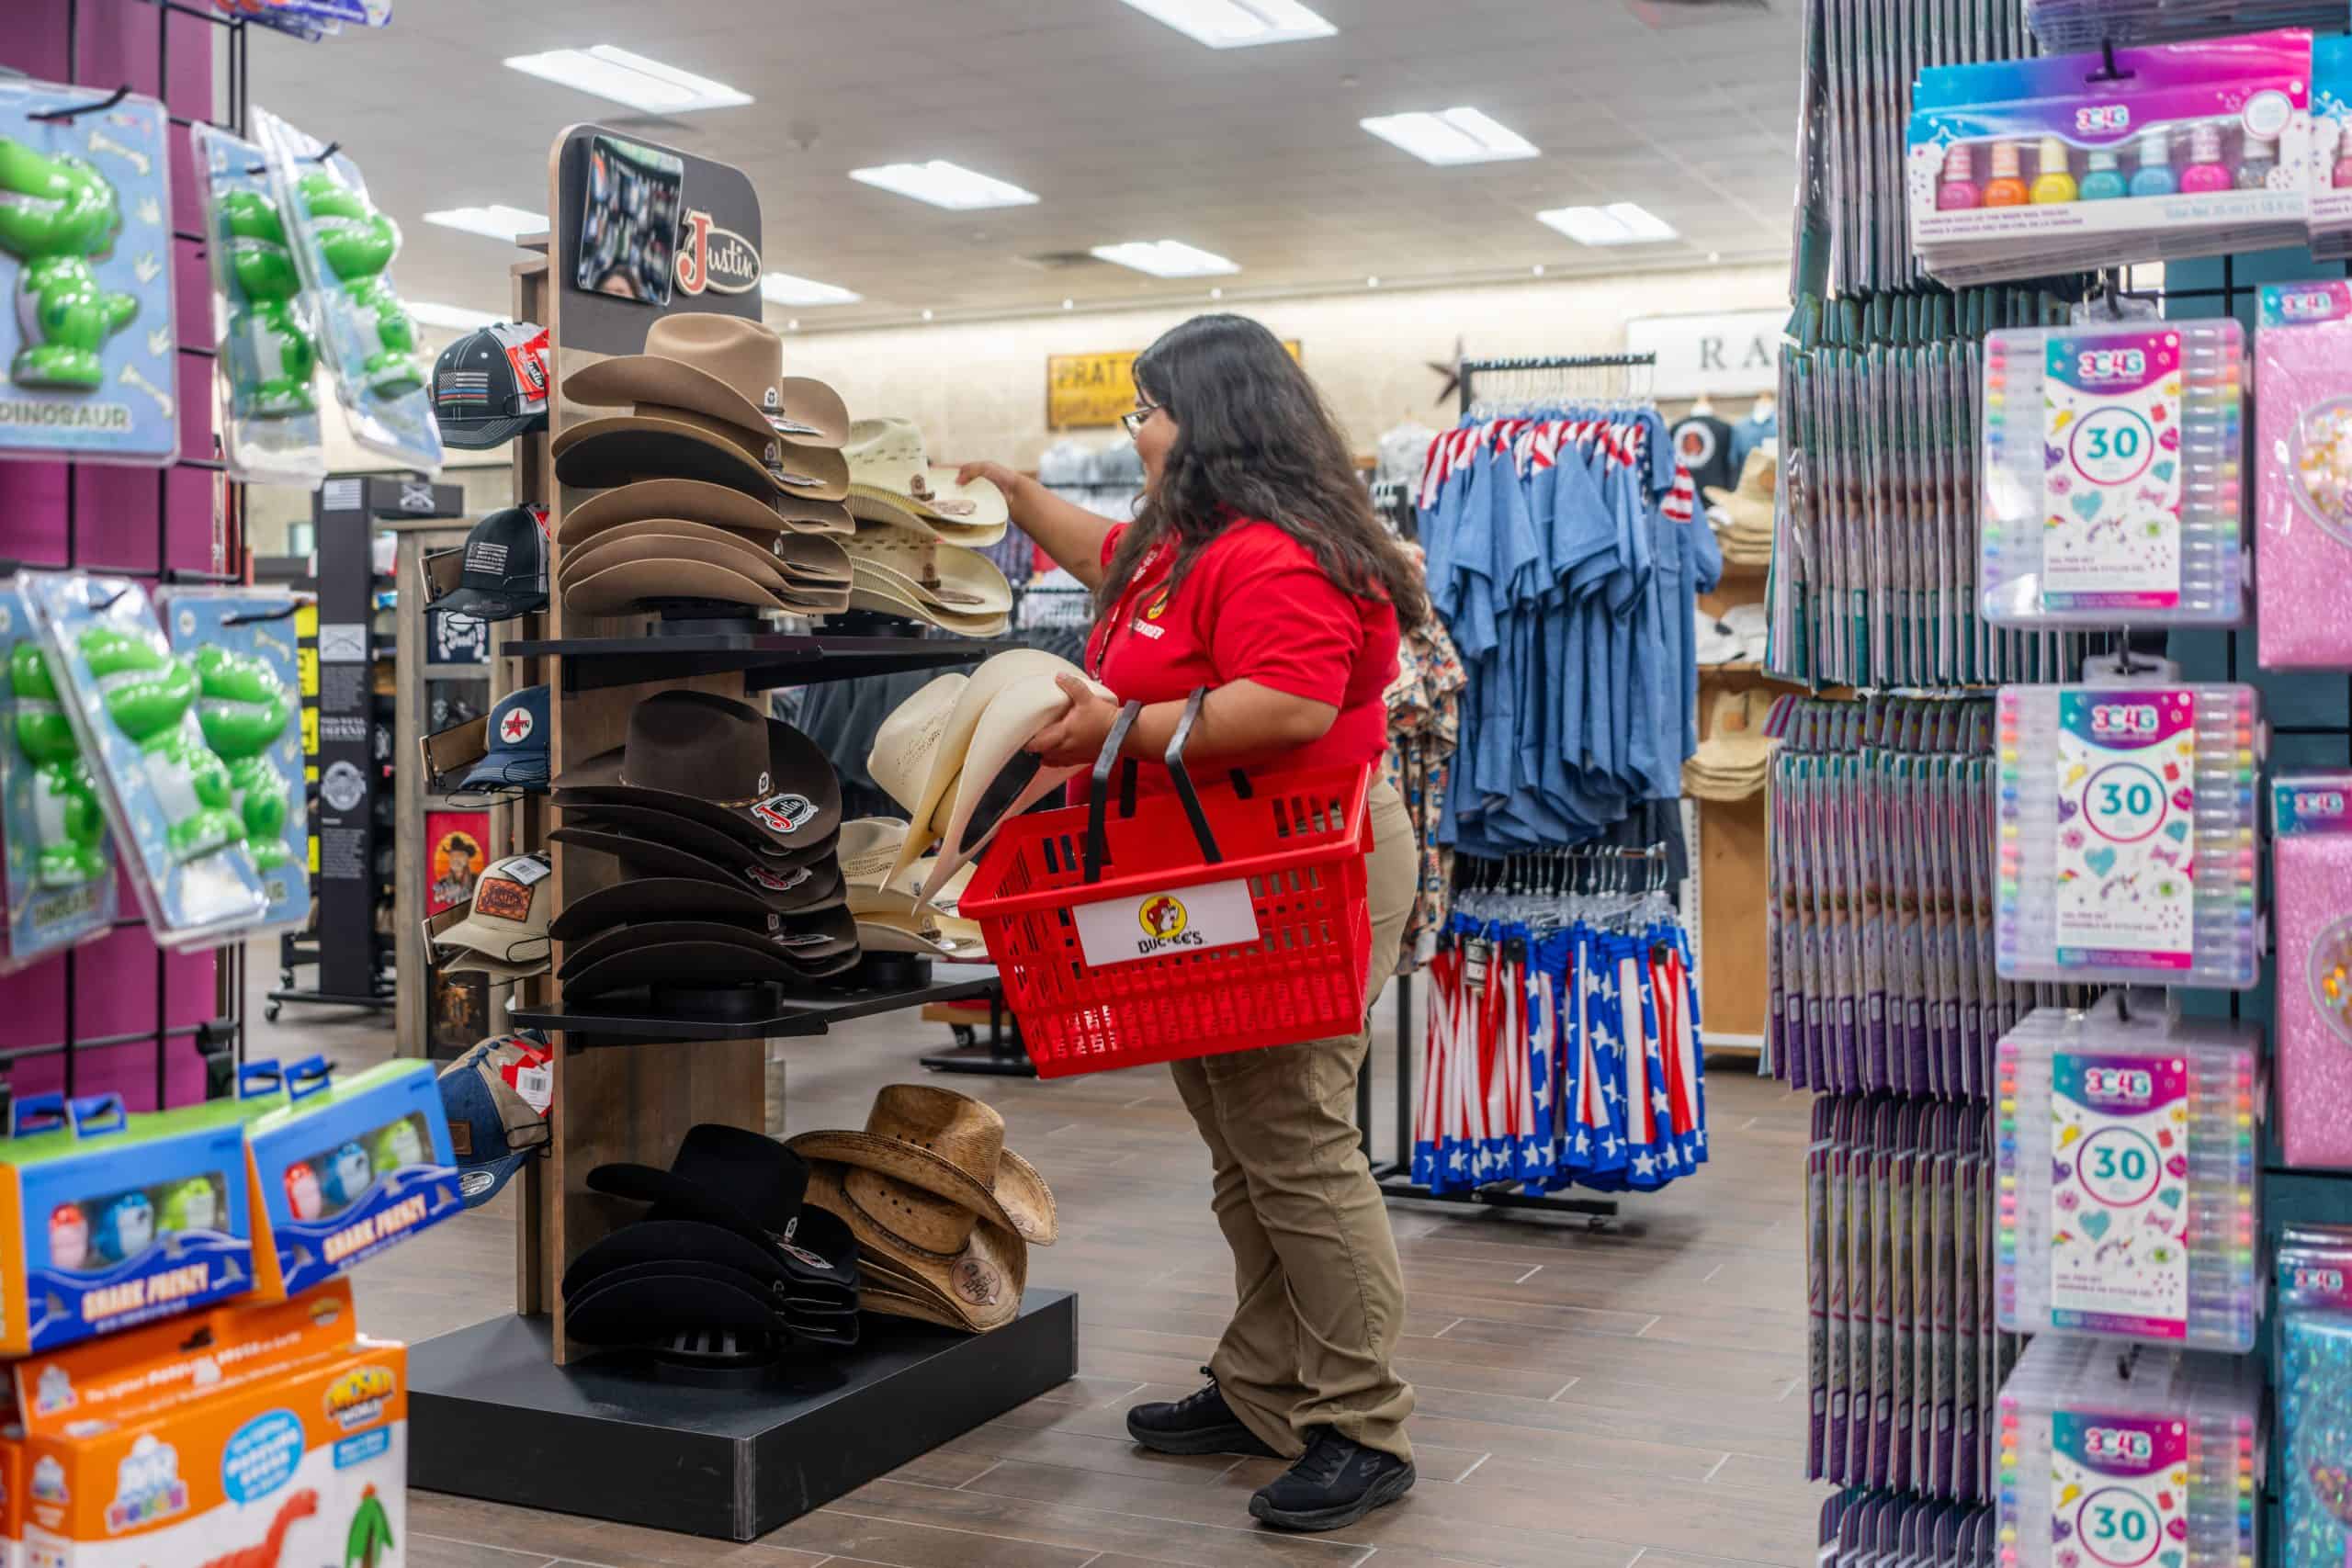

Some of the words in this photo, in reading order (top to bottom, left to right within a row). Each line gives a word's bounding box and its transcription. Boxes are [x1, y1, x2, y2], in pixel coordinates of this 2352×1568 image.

[679, 216, 754, 292] Justin
[2086, 427, 2140, 459] 30
[2099, 784, 2153, 816] 30
[2093, 1146, 2146, 1181] 30
[2093, 1506, 2146, 1542] 30
